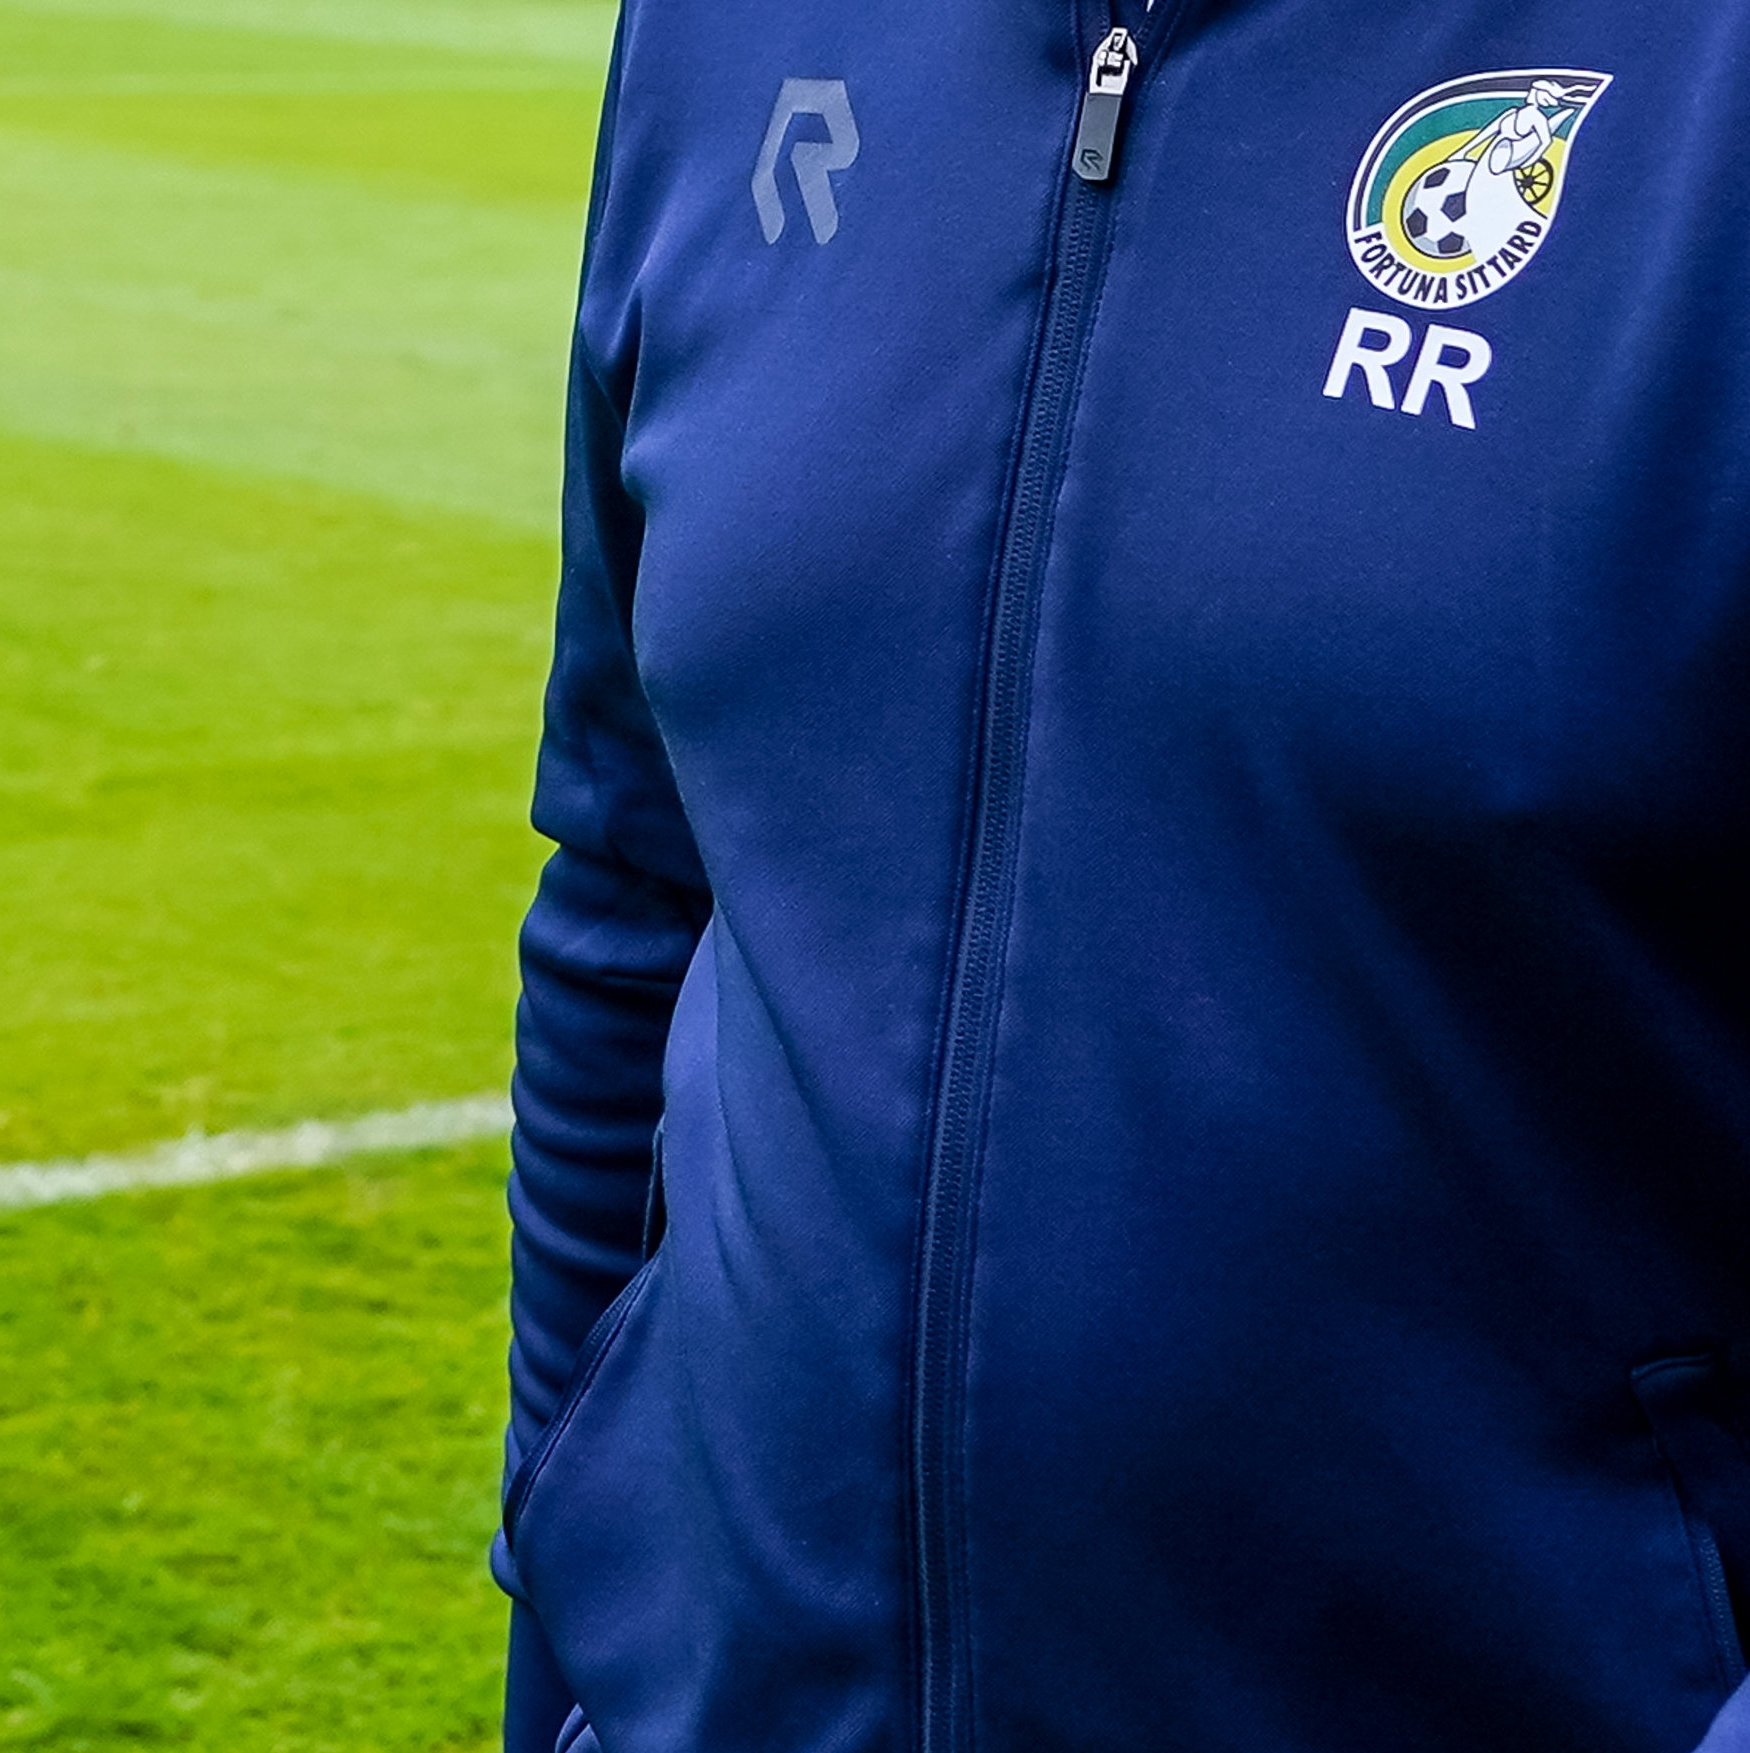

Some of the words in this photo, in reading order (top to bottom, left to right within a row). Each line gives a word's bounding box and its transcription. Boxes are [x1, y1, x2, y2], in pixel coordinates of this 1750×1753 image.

[1353, 230, 1449, 304] FORTUNA
[1455, 219, 1543, 301] SITTARD
[1322, 306, 1492, 431] RR
